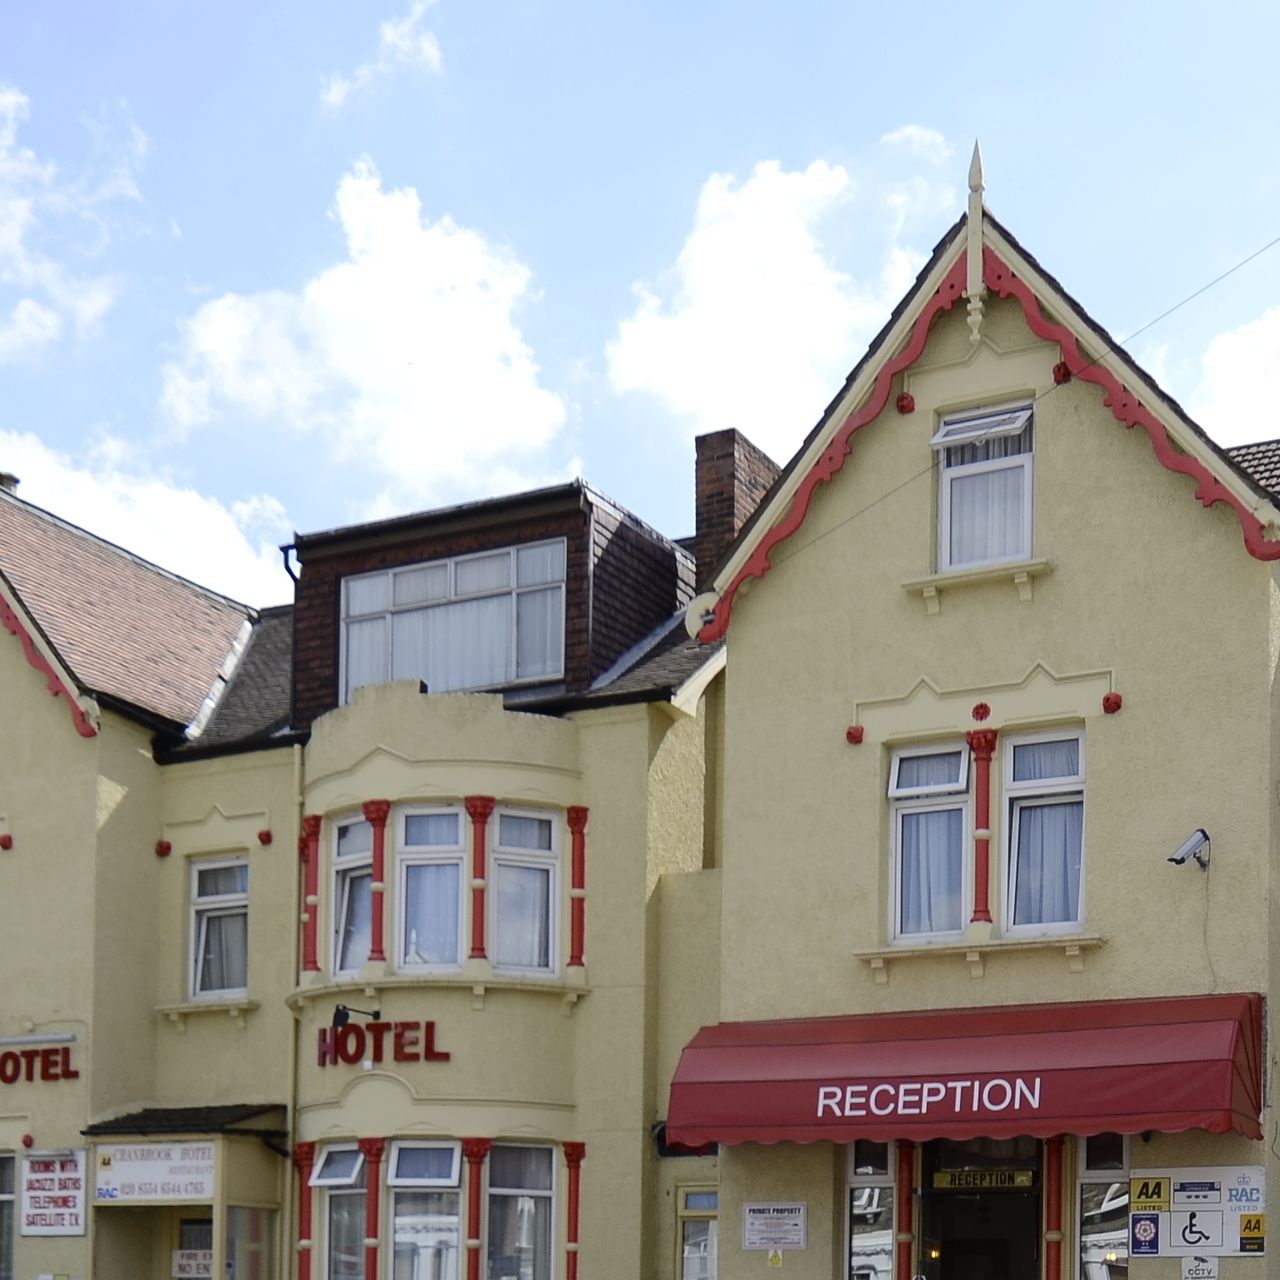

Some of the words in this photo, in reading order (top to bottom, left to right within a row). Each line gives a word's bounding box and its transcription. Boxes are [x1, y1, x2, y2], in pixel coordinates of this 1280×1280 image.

[317, 1020, 450, 1067] HOTEL
[816, 1077, 1041, 1118] RECEPTION
[112, 1148, 173, 1162] CRANBROOK
[180, 1146, 213, 1161] HOTEL
[59, 1159, 78, 1173] WITH
[58, 1177, 81, 1191] BATHS
[949, 1171, 1016, 1186] RECEPTION
[96, 1187, 119, 1199] RAC
[1136, 1181, 1162, 1200] AA
[1227, 1188, 1261, 1203] RAC
[29, 1195, 77, 1209] TELEPHONES
[748, 1207, 771, 1215] PRIVATE
[772, 1207, 801, 1215] PROPERTY
[25, 1213, 65, 1227] SATELLITE
[1242, 1218, 1262, 1233] AA
[1187, 1268, 1213, 1276] CCTV
